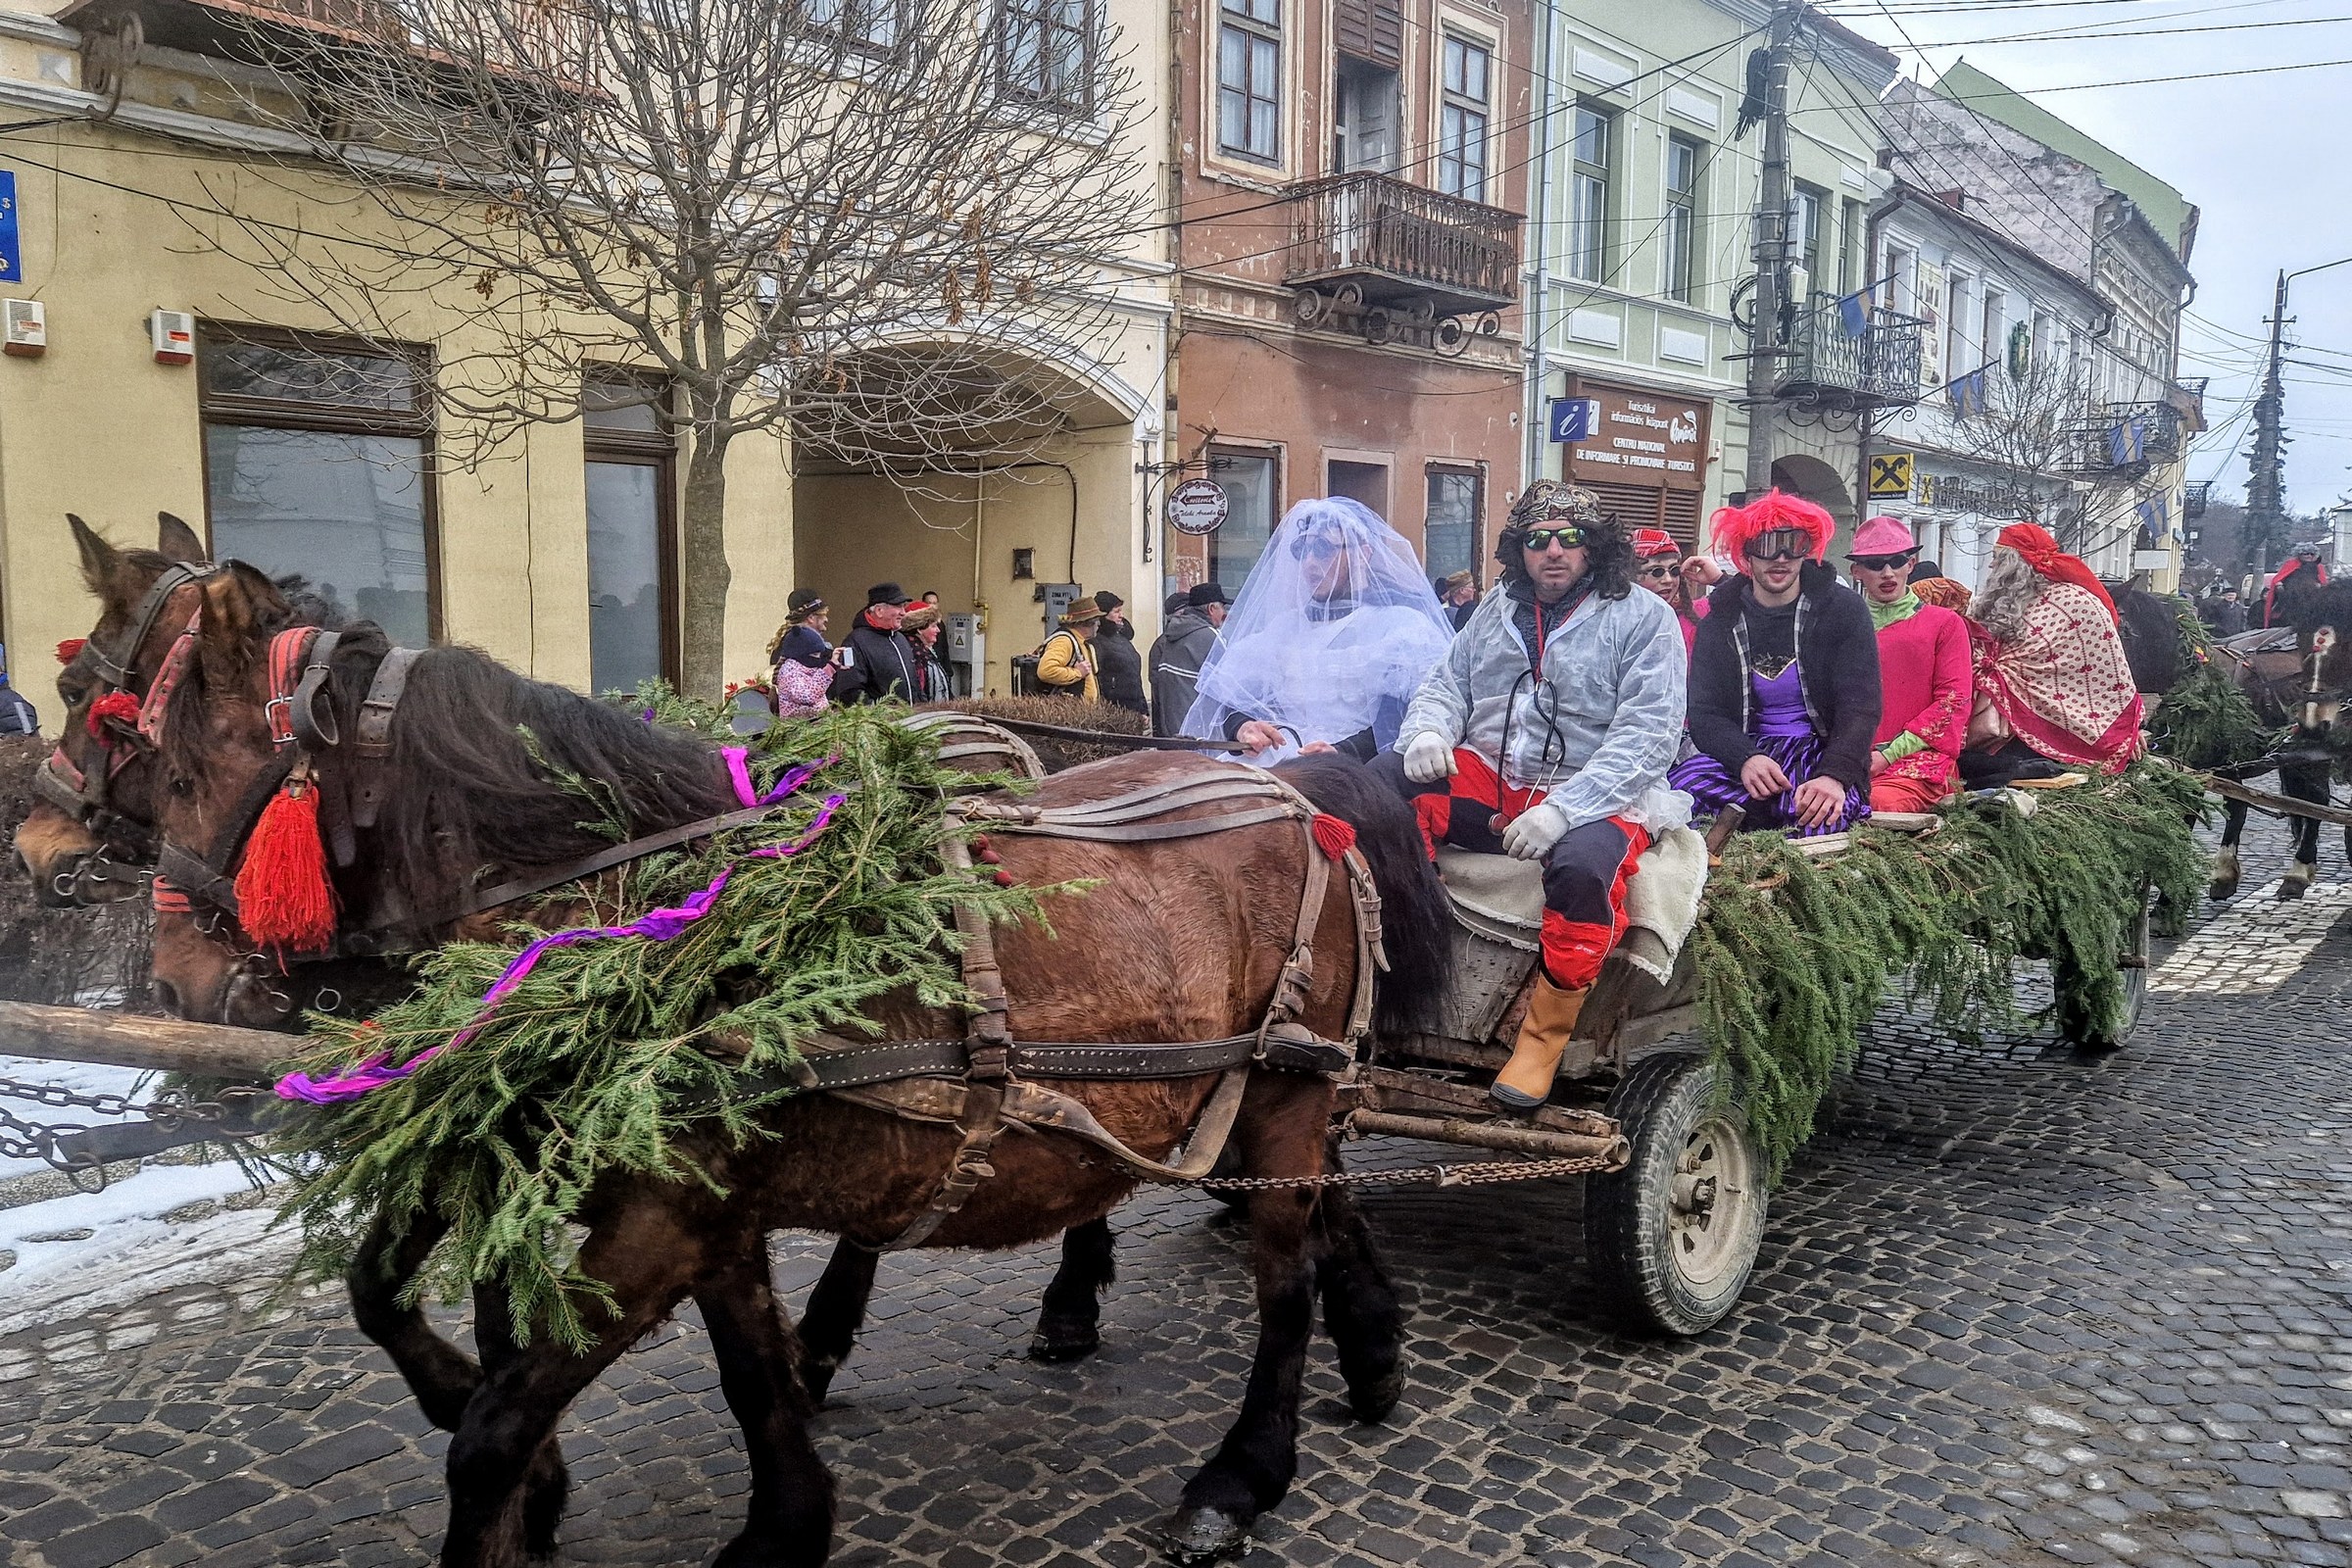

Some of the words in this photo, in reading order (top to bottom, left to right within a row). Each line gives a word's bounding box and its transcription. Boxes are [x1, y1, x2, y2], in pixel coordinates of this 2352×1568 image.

[1613, 437, 1638, 450] CENTRU
[1576, 449, 1585, 461] DE
[1585, 451, 1620, 465] INFORMARE
[1629, 456, 1665, 469] PROMOVARE
